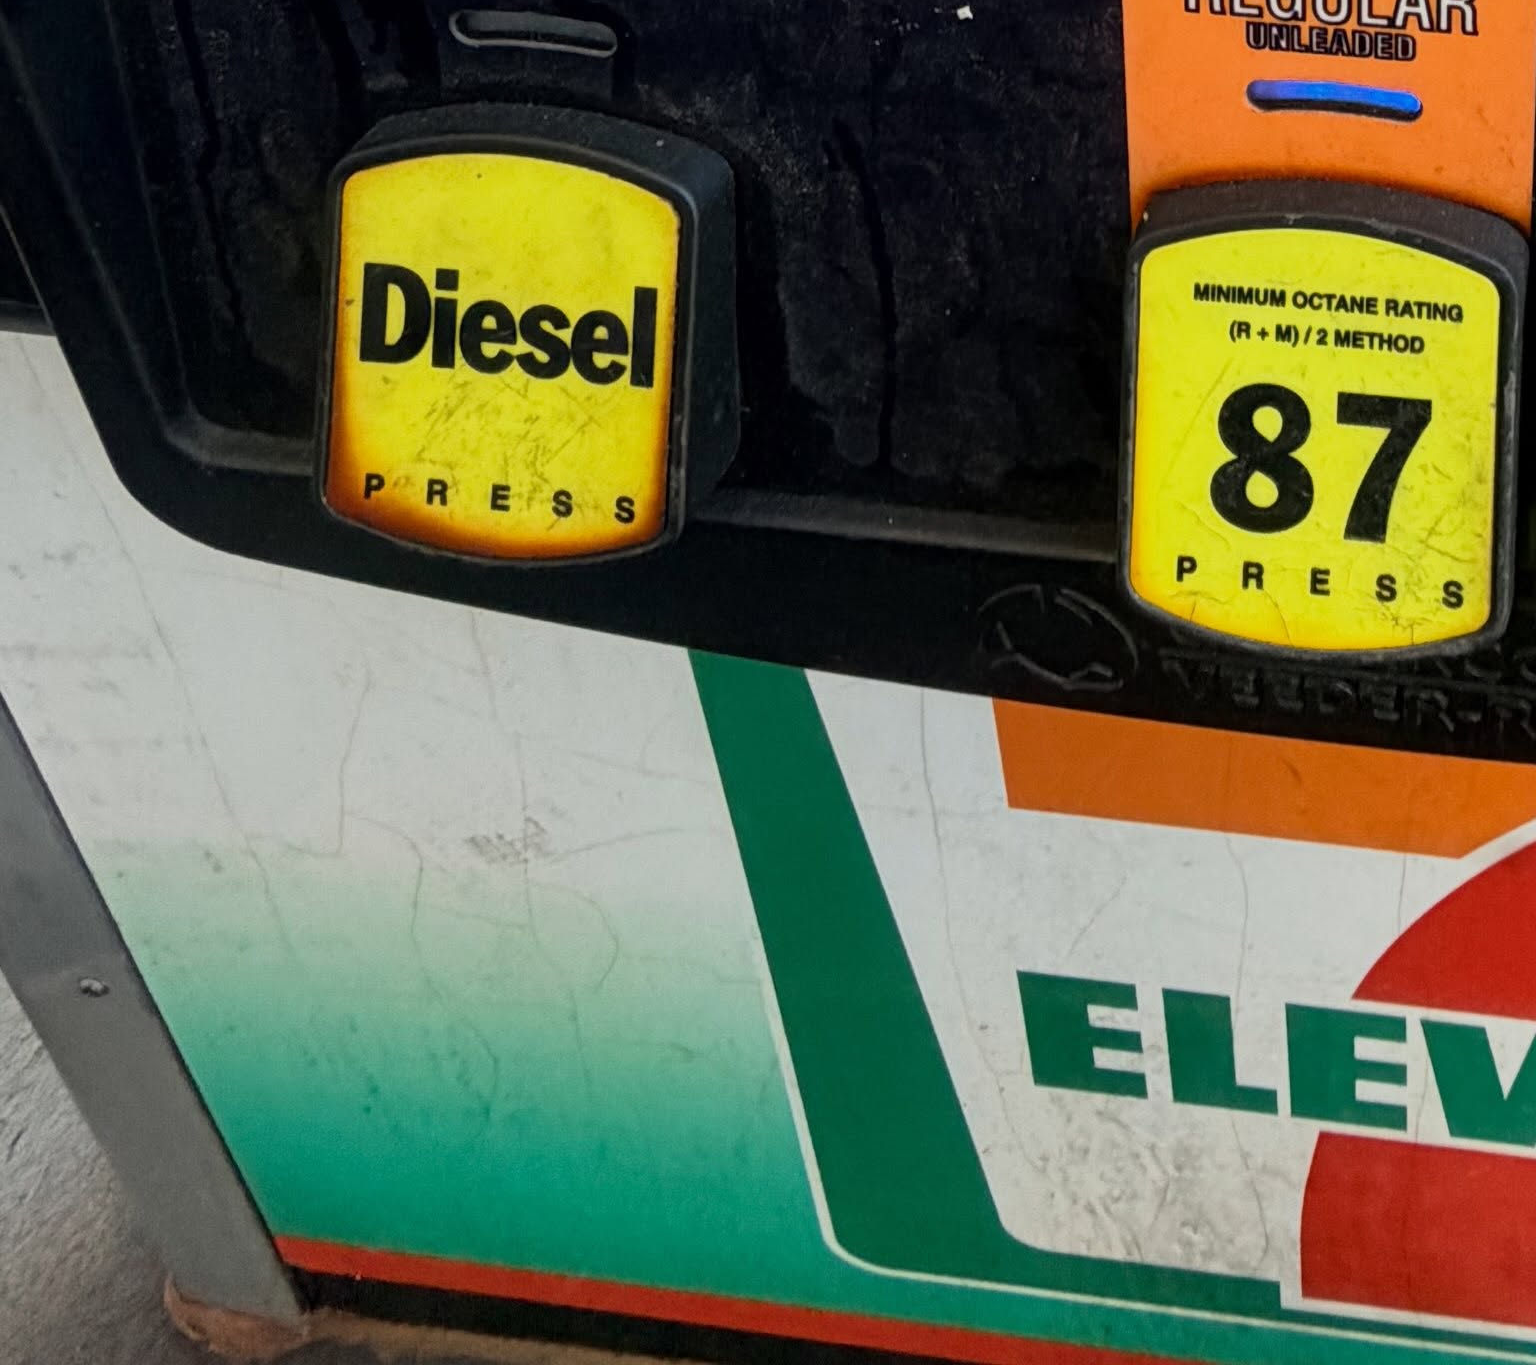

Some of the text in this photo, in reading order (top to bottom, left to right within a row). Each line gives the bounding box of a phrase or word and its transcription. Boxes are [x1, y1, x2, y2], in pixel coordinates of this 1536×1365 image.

[1245, 21, 1417, 61] UNLEADED
[359, 261, 658, 389] Diesel
[1193, 282, 1464, 323] MINIMUM OCTANE RATING
[1316, 327, 1329, 347] 2
[1333, 329, 1425, 354] METHOD
[1210, 382, 1433, 545] 87
[363, 472, 636, 525] PRESS
[1175, 555, 1465, 610] PRESS
